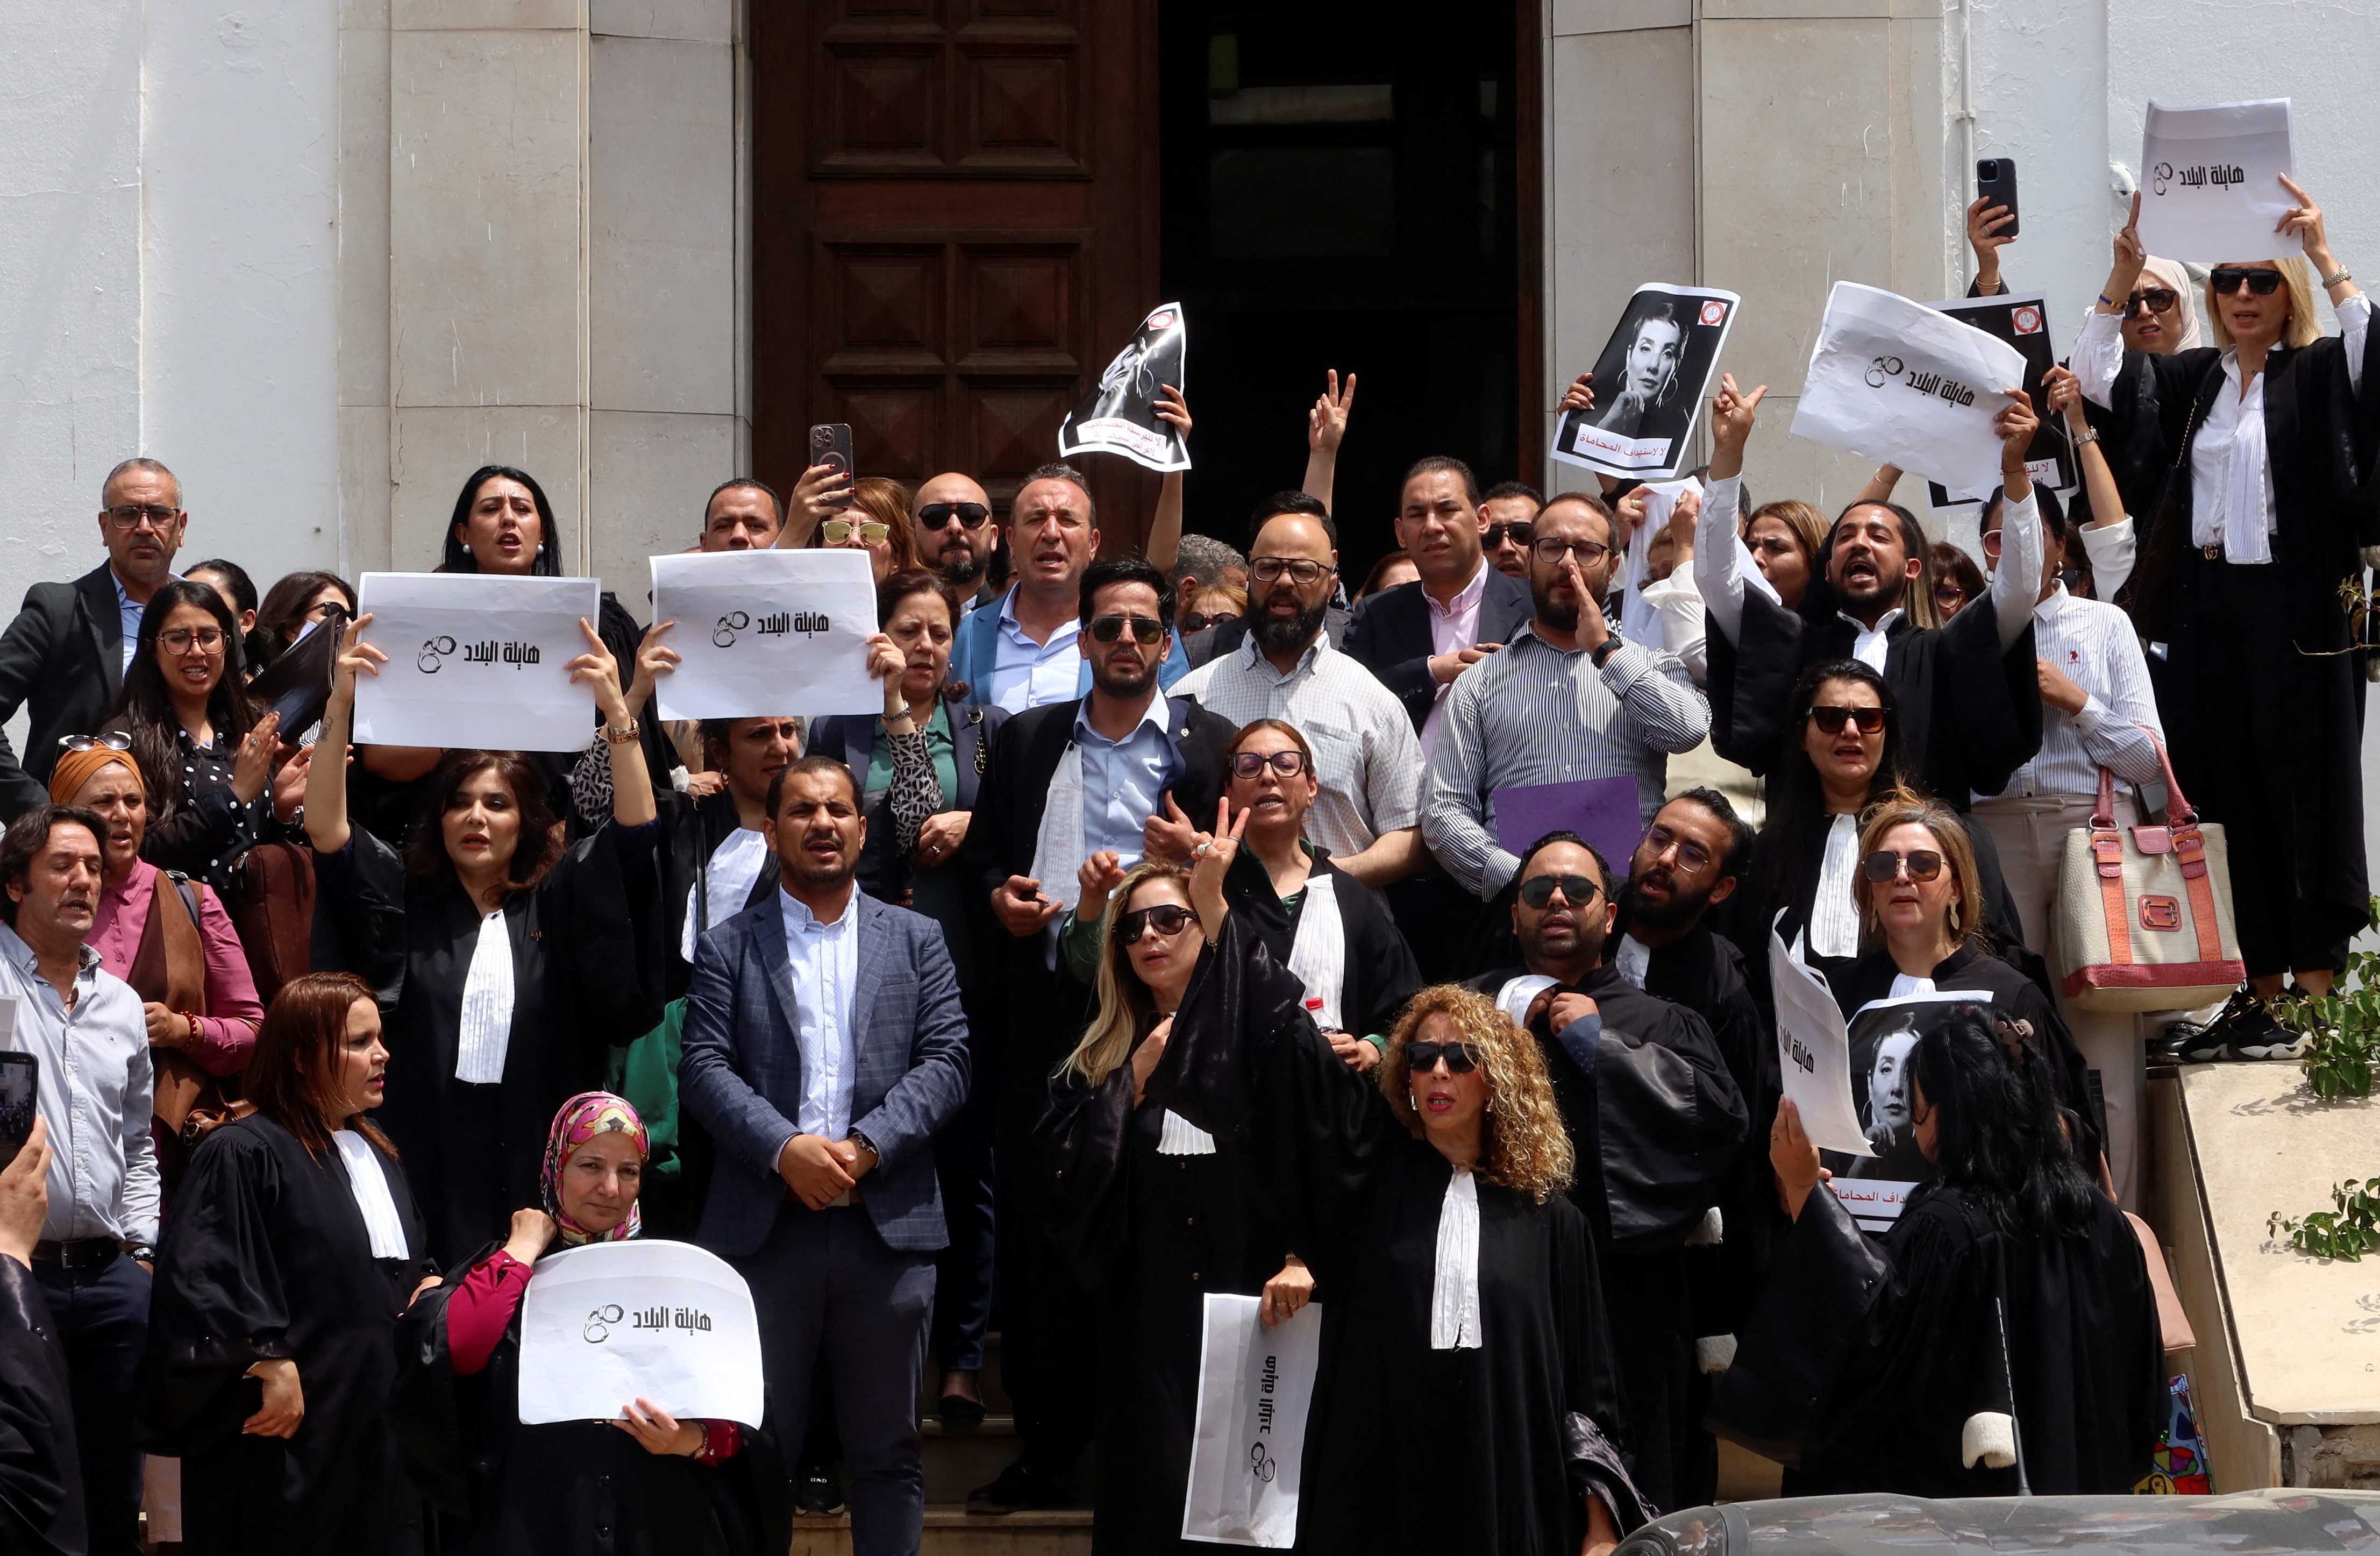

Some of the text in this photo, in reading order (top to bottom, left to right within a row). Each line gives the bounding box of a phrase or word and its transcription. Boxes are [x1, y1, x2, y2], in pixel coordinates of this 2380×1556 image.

[2178, 164, 2244, 191] هايلة البلاد
[1905, 371, 1975, 408] هايلة البلاد
[1094, 431, 1129, 442] سياسة
[1155, 437, 1161, 446] لا
[1579, 434, 1667, 459] لا لاستهداف المحاماة
[757, 612, 829, 638] هايلة البلاد
[464, 641, 540, 670] هايلة البلاد
[1792, 1039, 1814, 1074] هايلة
[632, 1306, 711, 1336] هايلة البلاد
[1258, 1355, 1279, 1434] هايلة البلاد
